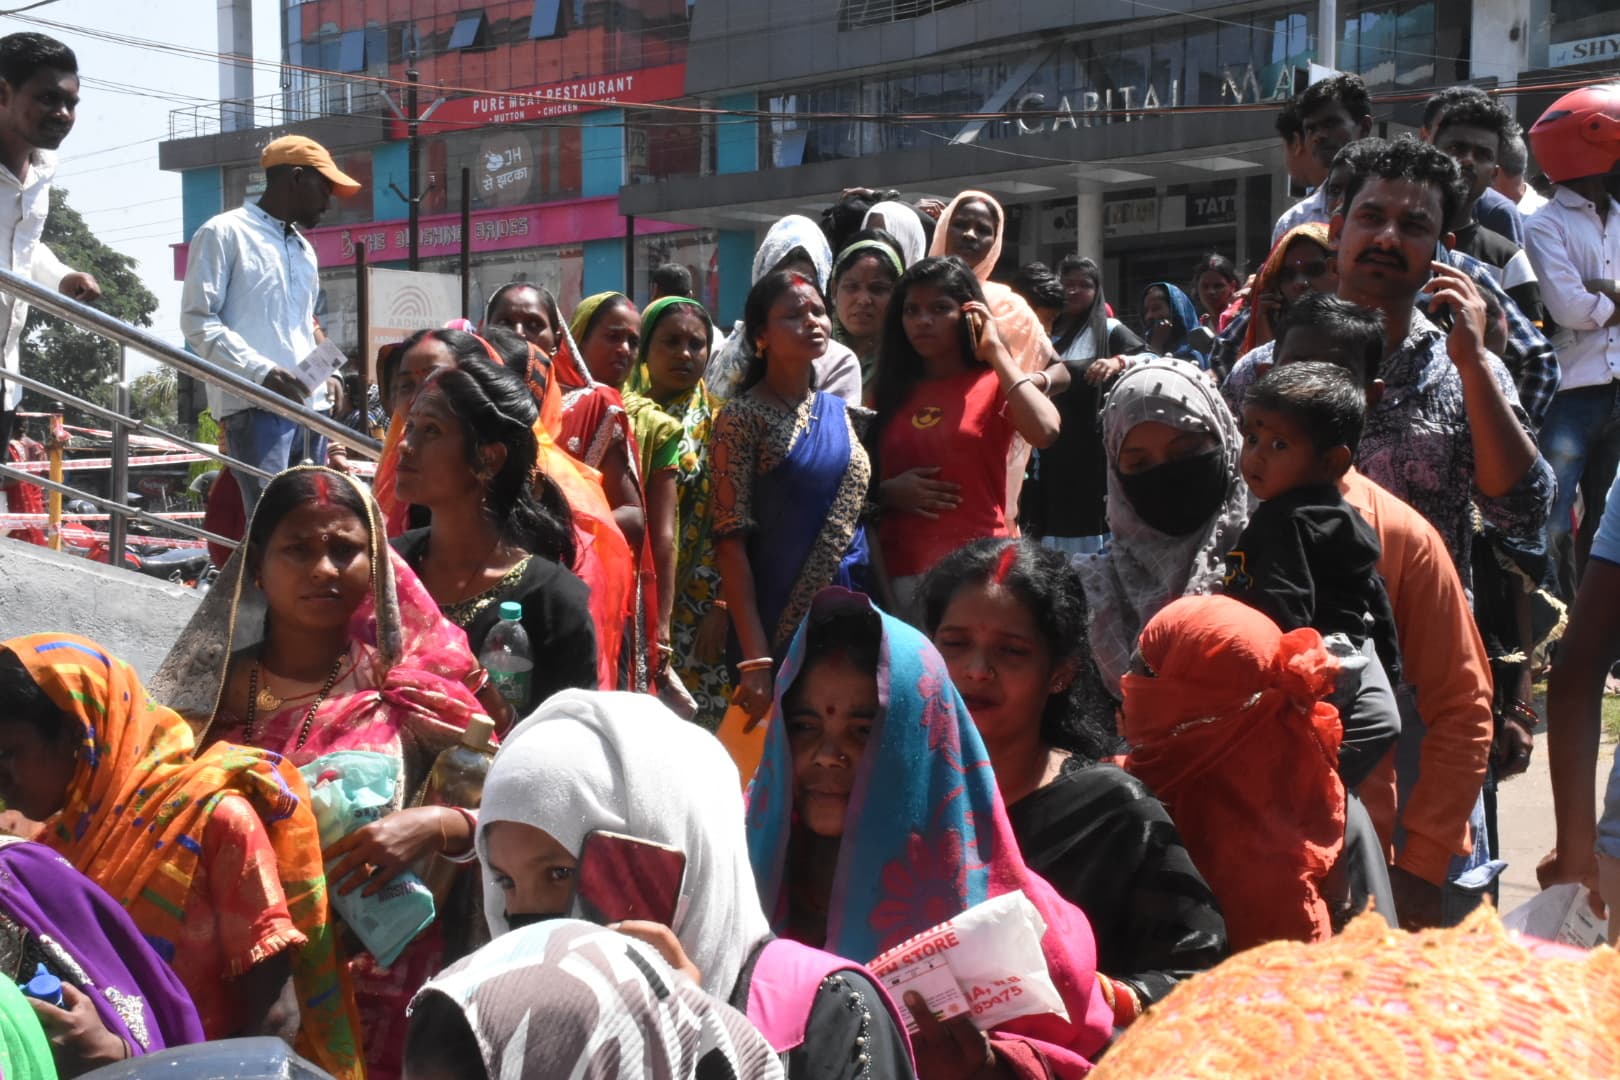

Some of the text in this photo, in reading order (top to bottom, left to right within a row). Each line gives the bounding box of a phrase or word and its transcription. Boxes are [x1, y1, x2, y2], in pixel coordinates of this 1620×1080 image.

[473, 76, 634, 114] PURE MEAT RESTAURANT
[493, 111, 525, 123] MUTTON
[543, 104, 578, 116] CHICKEN
[504, 147, 522, 166] JH
[482, 174, 493, 190] से
[475, 217, 530, 241] BRIDES
[902, 931, 960, 965] STORE
